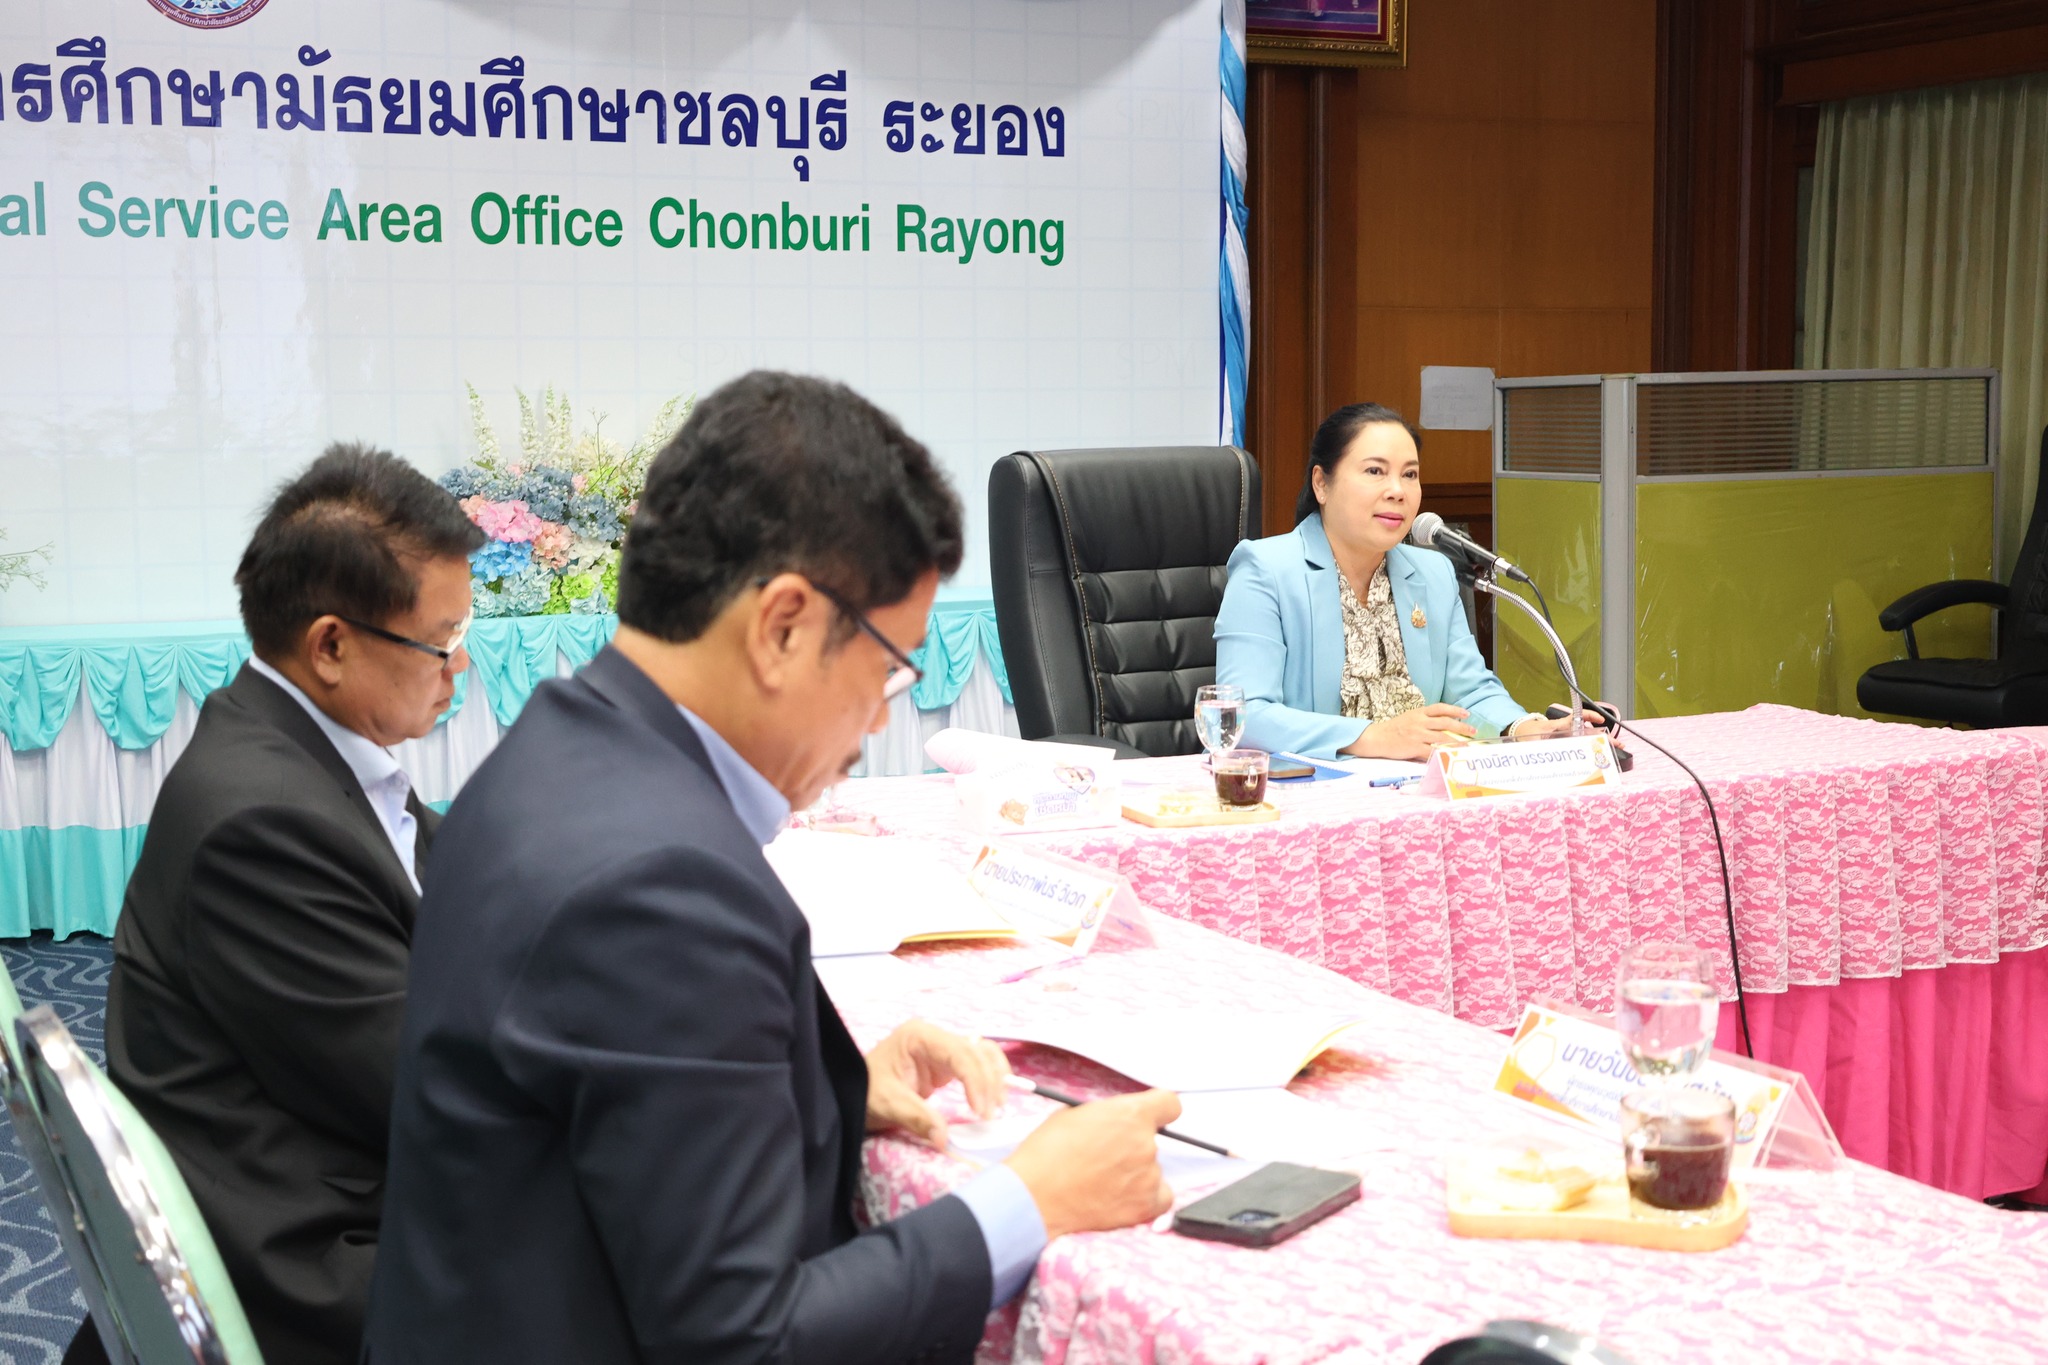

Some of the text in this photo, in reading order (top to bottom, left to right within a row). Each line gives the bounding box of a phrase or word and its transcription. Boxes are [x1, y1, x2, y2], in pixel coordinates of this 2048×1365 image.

[0, 36, 1065, 182] รศึกษามัธยมศึกษาชลบุรี ระยอง
[0, 181, 1065, 267] al Service Area Office Chonburi Rayong
